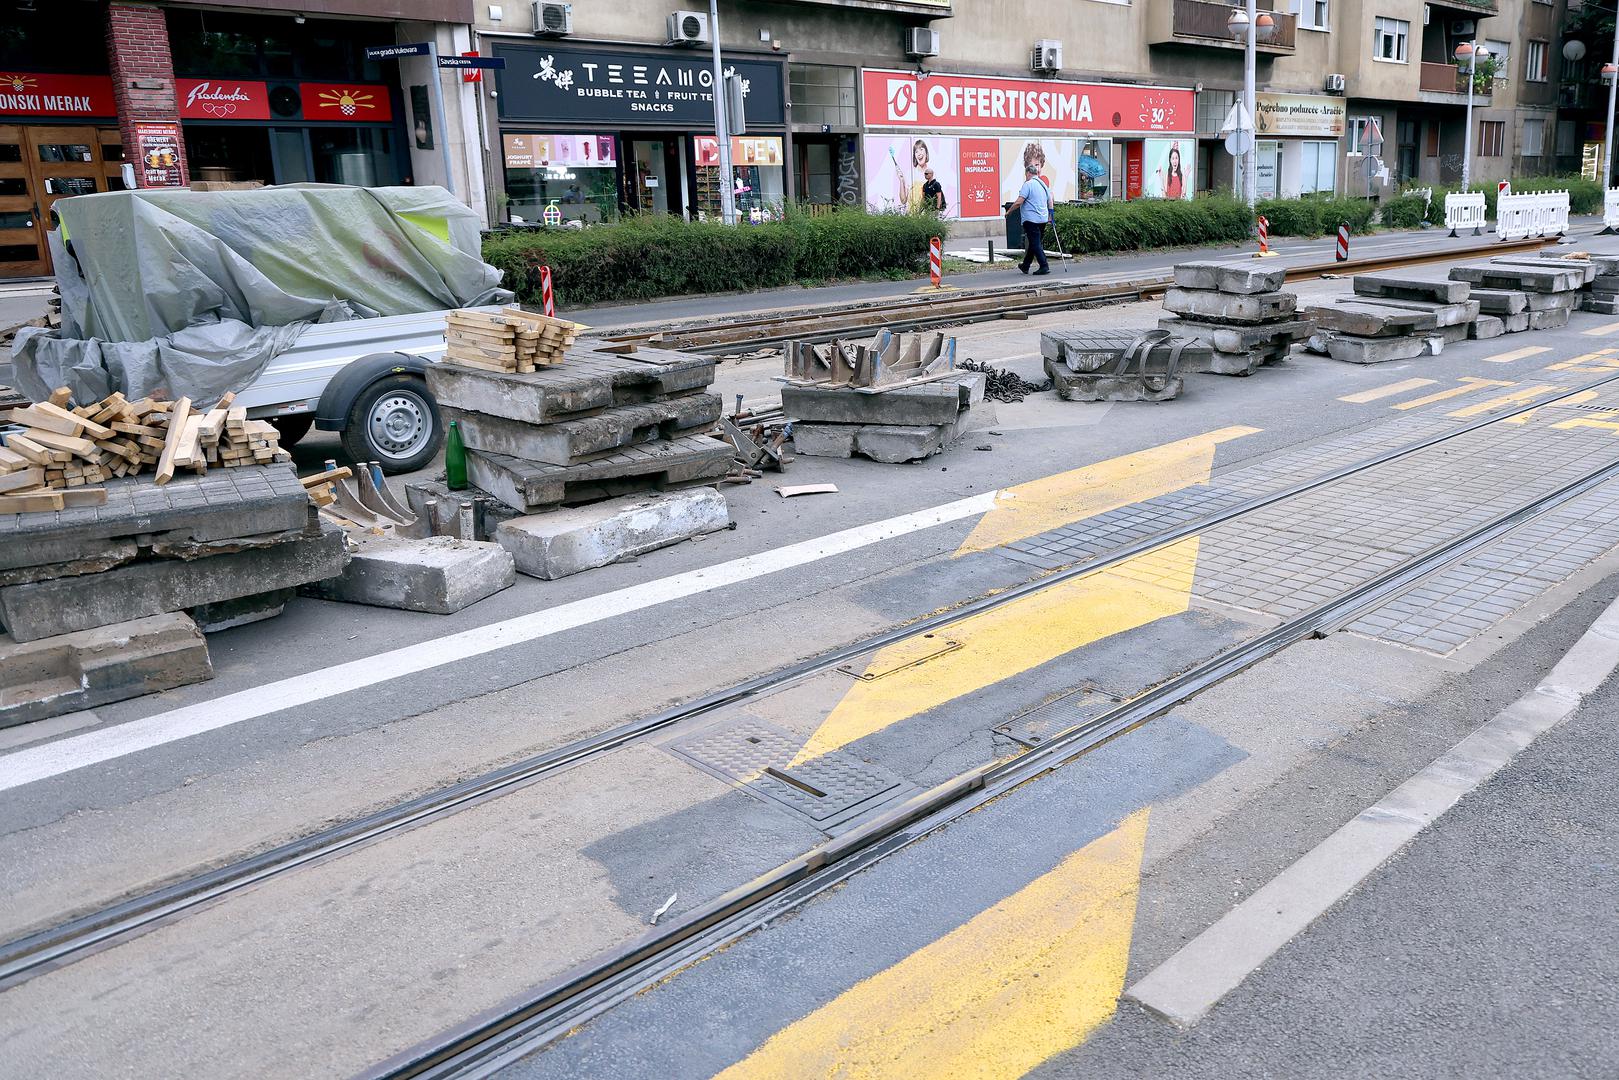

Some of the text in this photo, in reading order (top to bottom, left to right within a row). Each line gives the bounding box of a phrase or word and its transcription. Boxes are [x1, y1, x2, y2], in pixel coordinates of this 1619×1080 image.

[380, 48, 394, 57] grada
[394, 46, 418, 55] Vukovara
[186, 82, 250, 108] Radenska
[577, 88, 713, 101] BUBBLE TEA FRUIT TE
[44, 95, 92, 111] MERAK
[631, 103, 674, 112] SNACKS
[927, 85, 1093, 122] OFFERTISSIMA
[1151, 108, 1164, 123] 30
[739, 139, 782, 161] TEA
